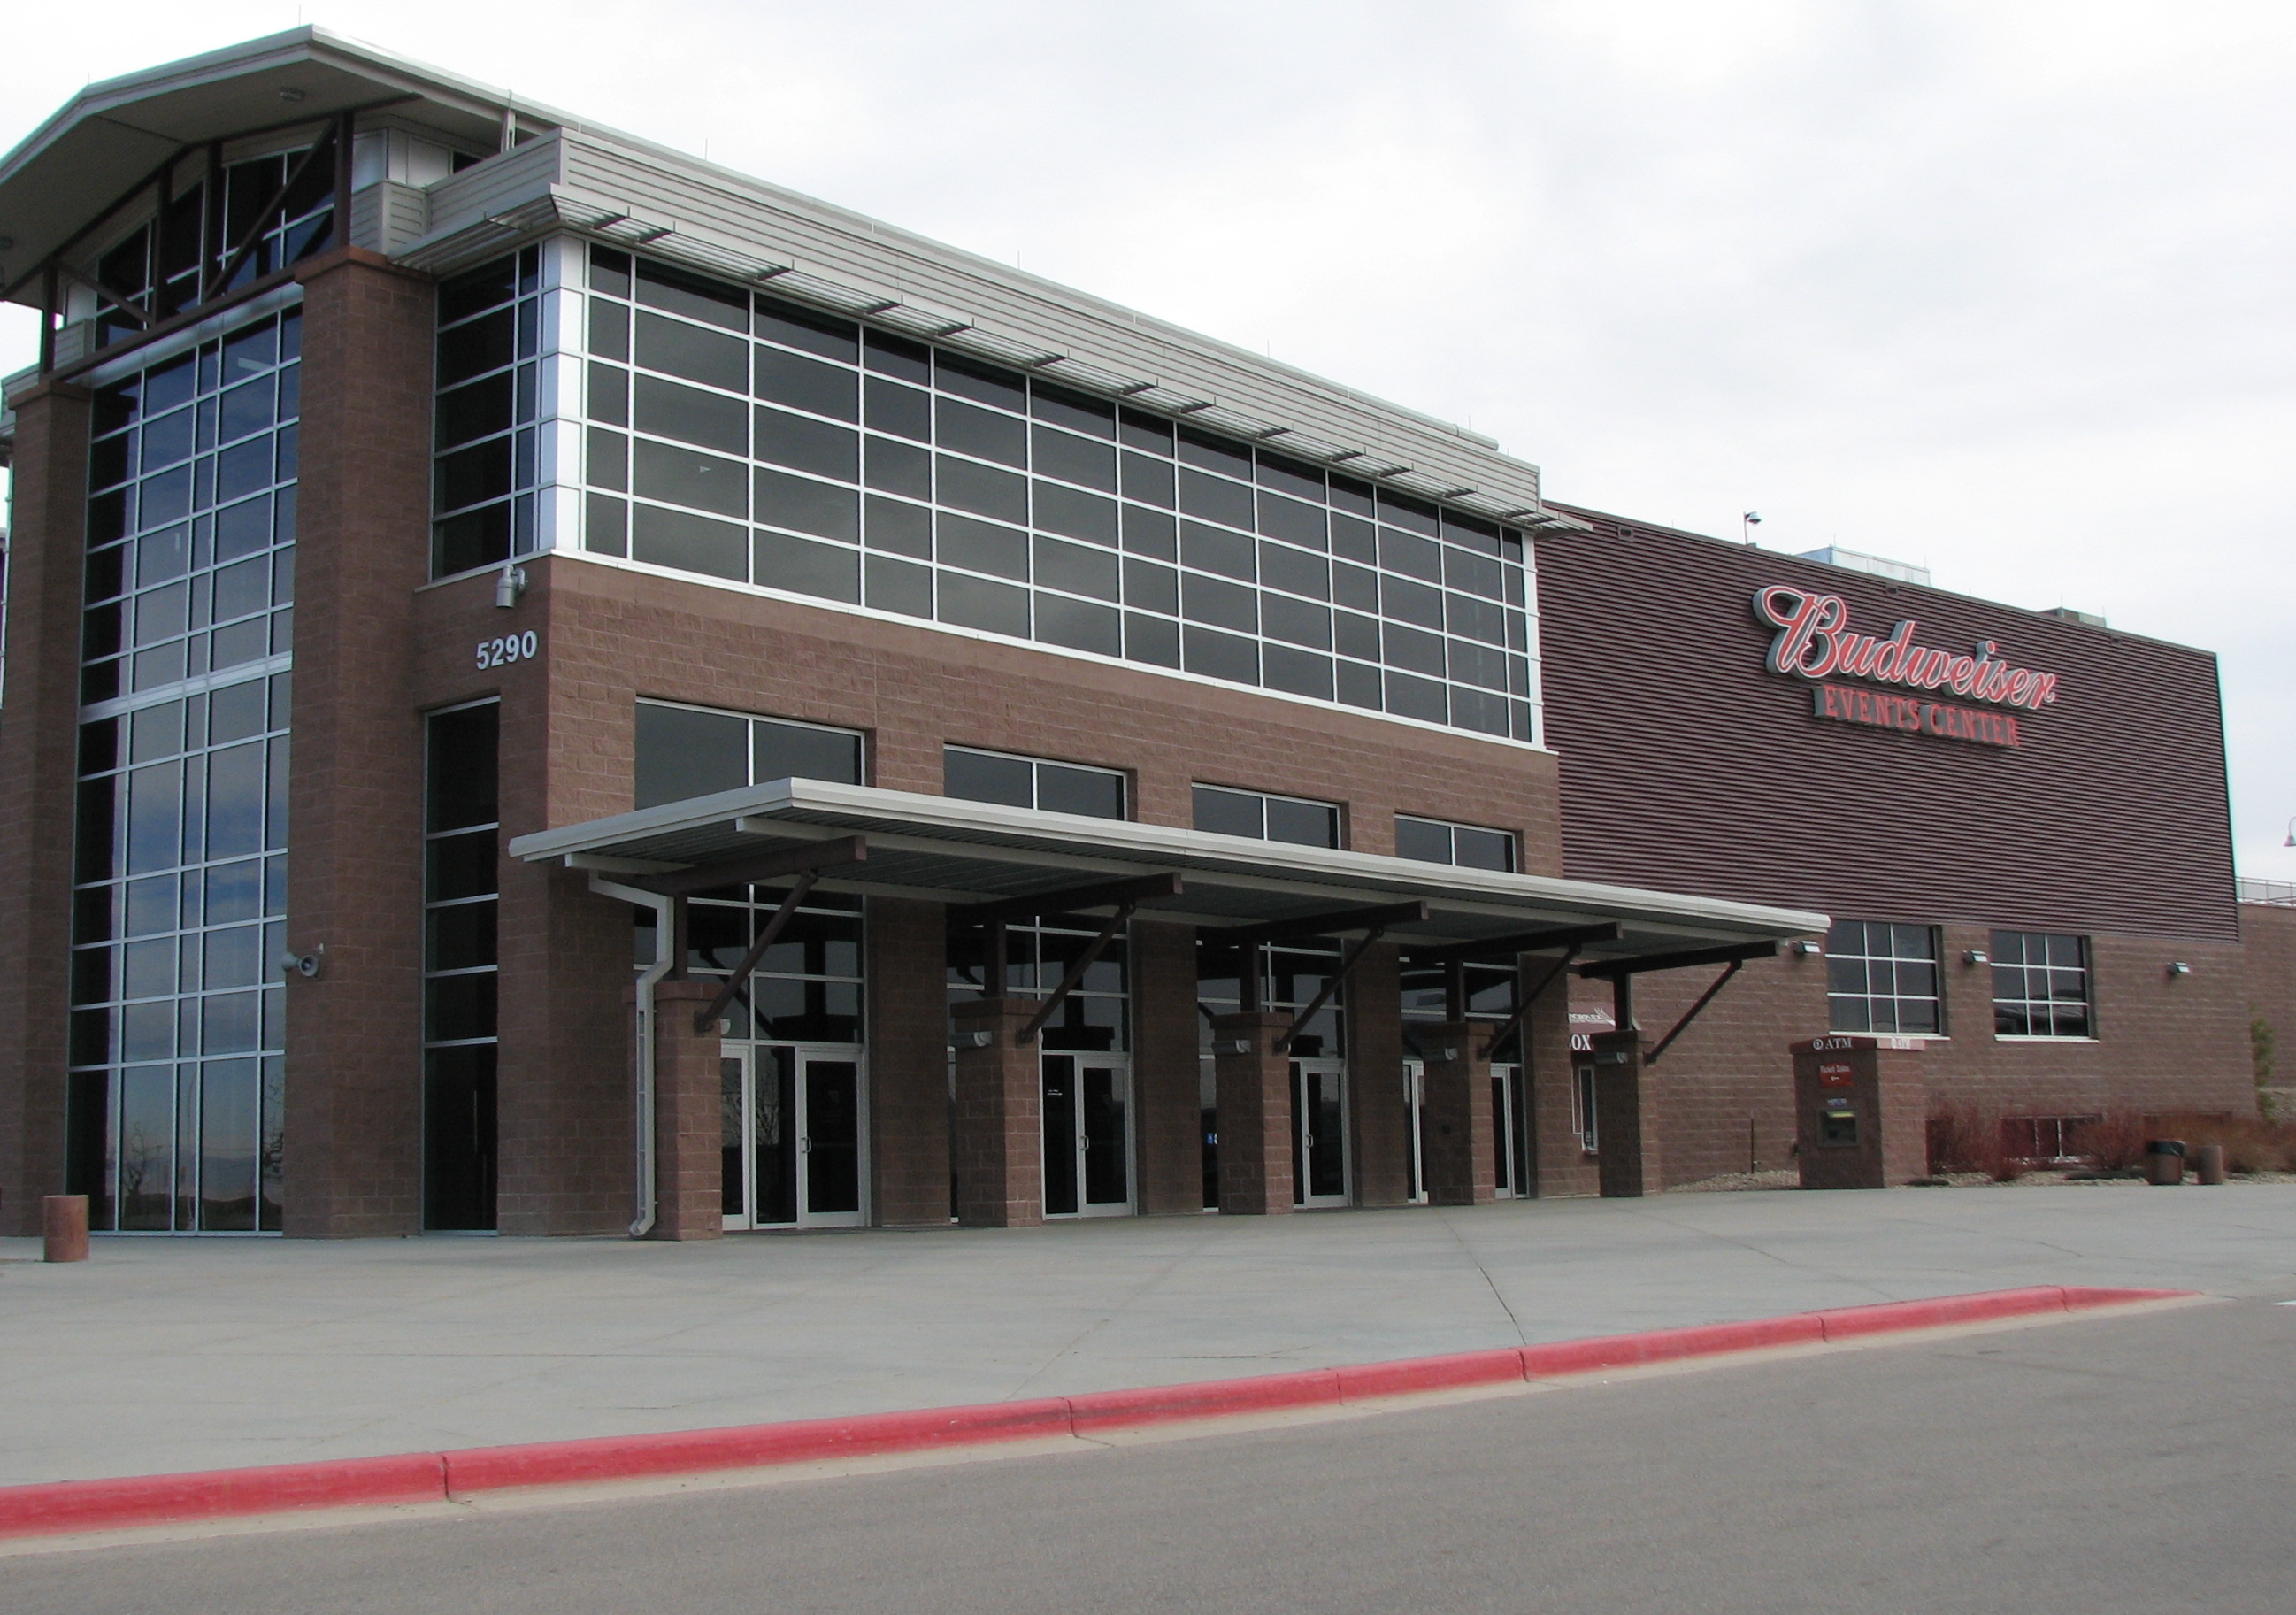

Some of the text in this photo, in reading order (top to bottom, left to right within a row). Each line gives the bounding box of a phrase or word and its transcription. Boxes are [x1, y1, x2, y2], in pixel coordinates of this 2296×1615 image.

[476, 629, 538, 670] 5290
[1757, 584, 2057, 710] Budweiser
[1819, 684, 2023, 748] EVENTS CENTER
[1569, 1034, 1592, 1050] OX
[1825, 1037, 1853, 1049] ATM
